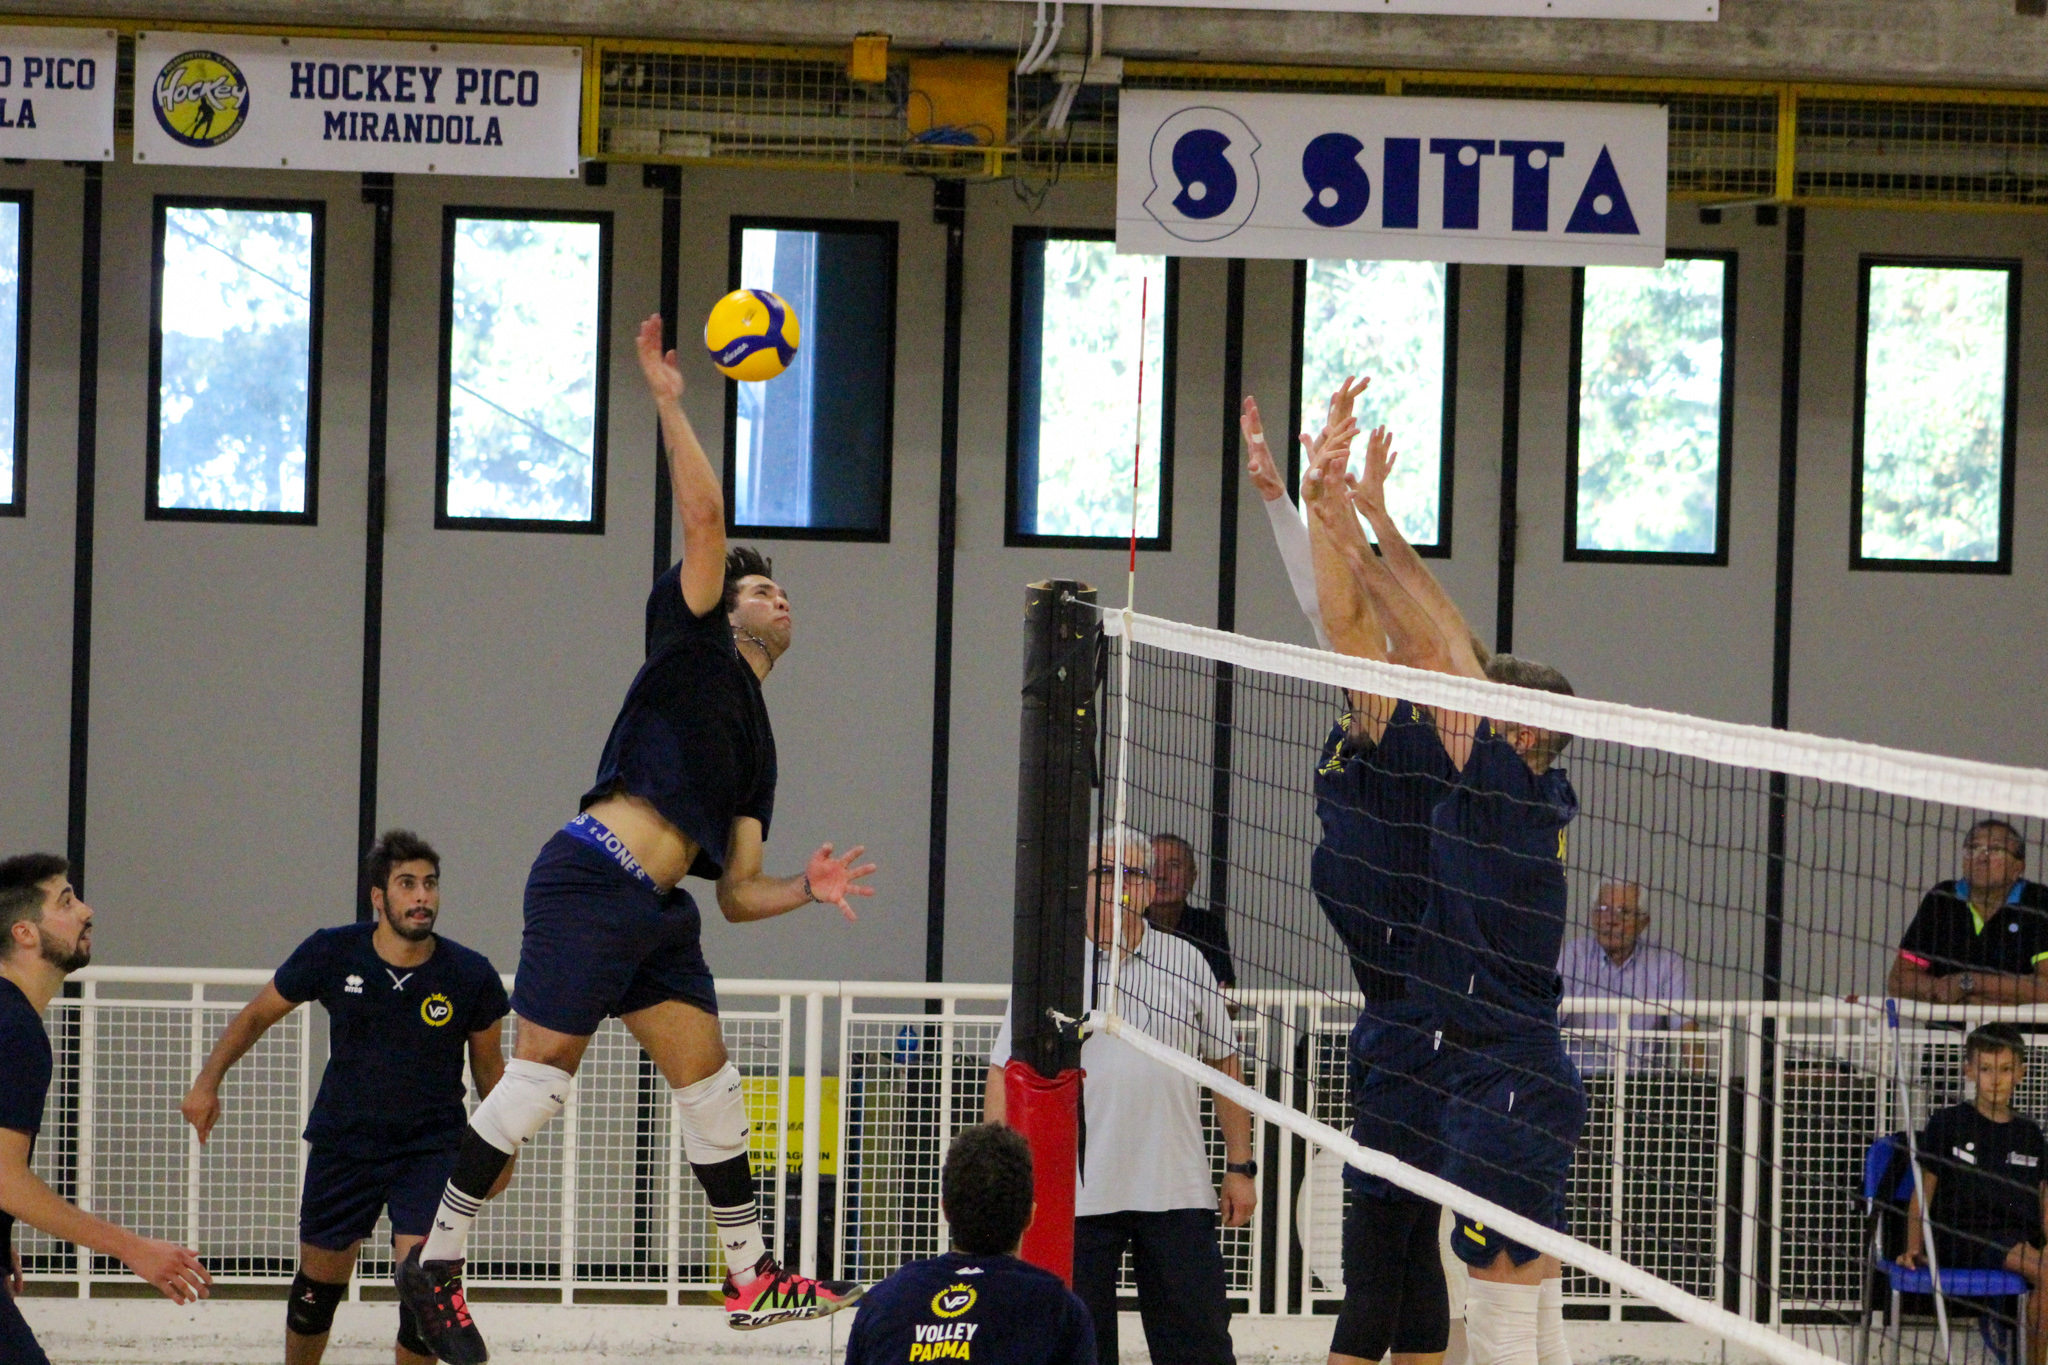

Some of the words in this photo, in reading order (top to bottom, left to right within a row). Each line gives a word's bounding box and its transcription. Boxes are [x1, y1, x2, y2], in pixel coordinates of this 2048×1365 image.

[23, 57, 96, 90] PICO
[290, 62, 442, 104] HOCKEY
[455, 67, 540, 107] PICO
[323, 110, 504, 146] MIRANDOLA
[1301, 131, 1641, 236] SITTA
[429, 1004, 448, 1018] VP
[944, 1296, 969, 1310] VP
[914, 1322, 979, 1343] VOLLEY
[908, 1340, 971, 1363] PARMA
